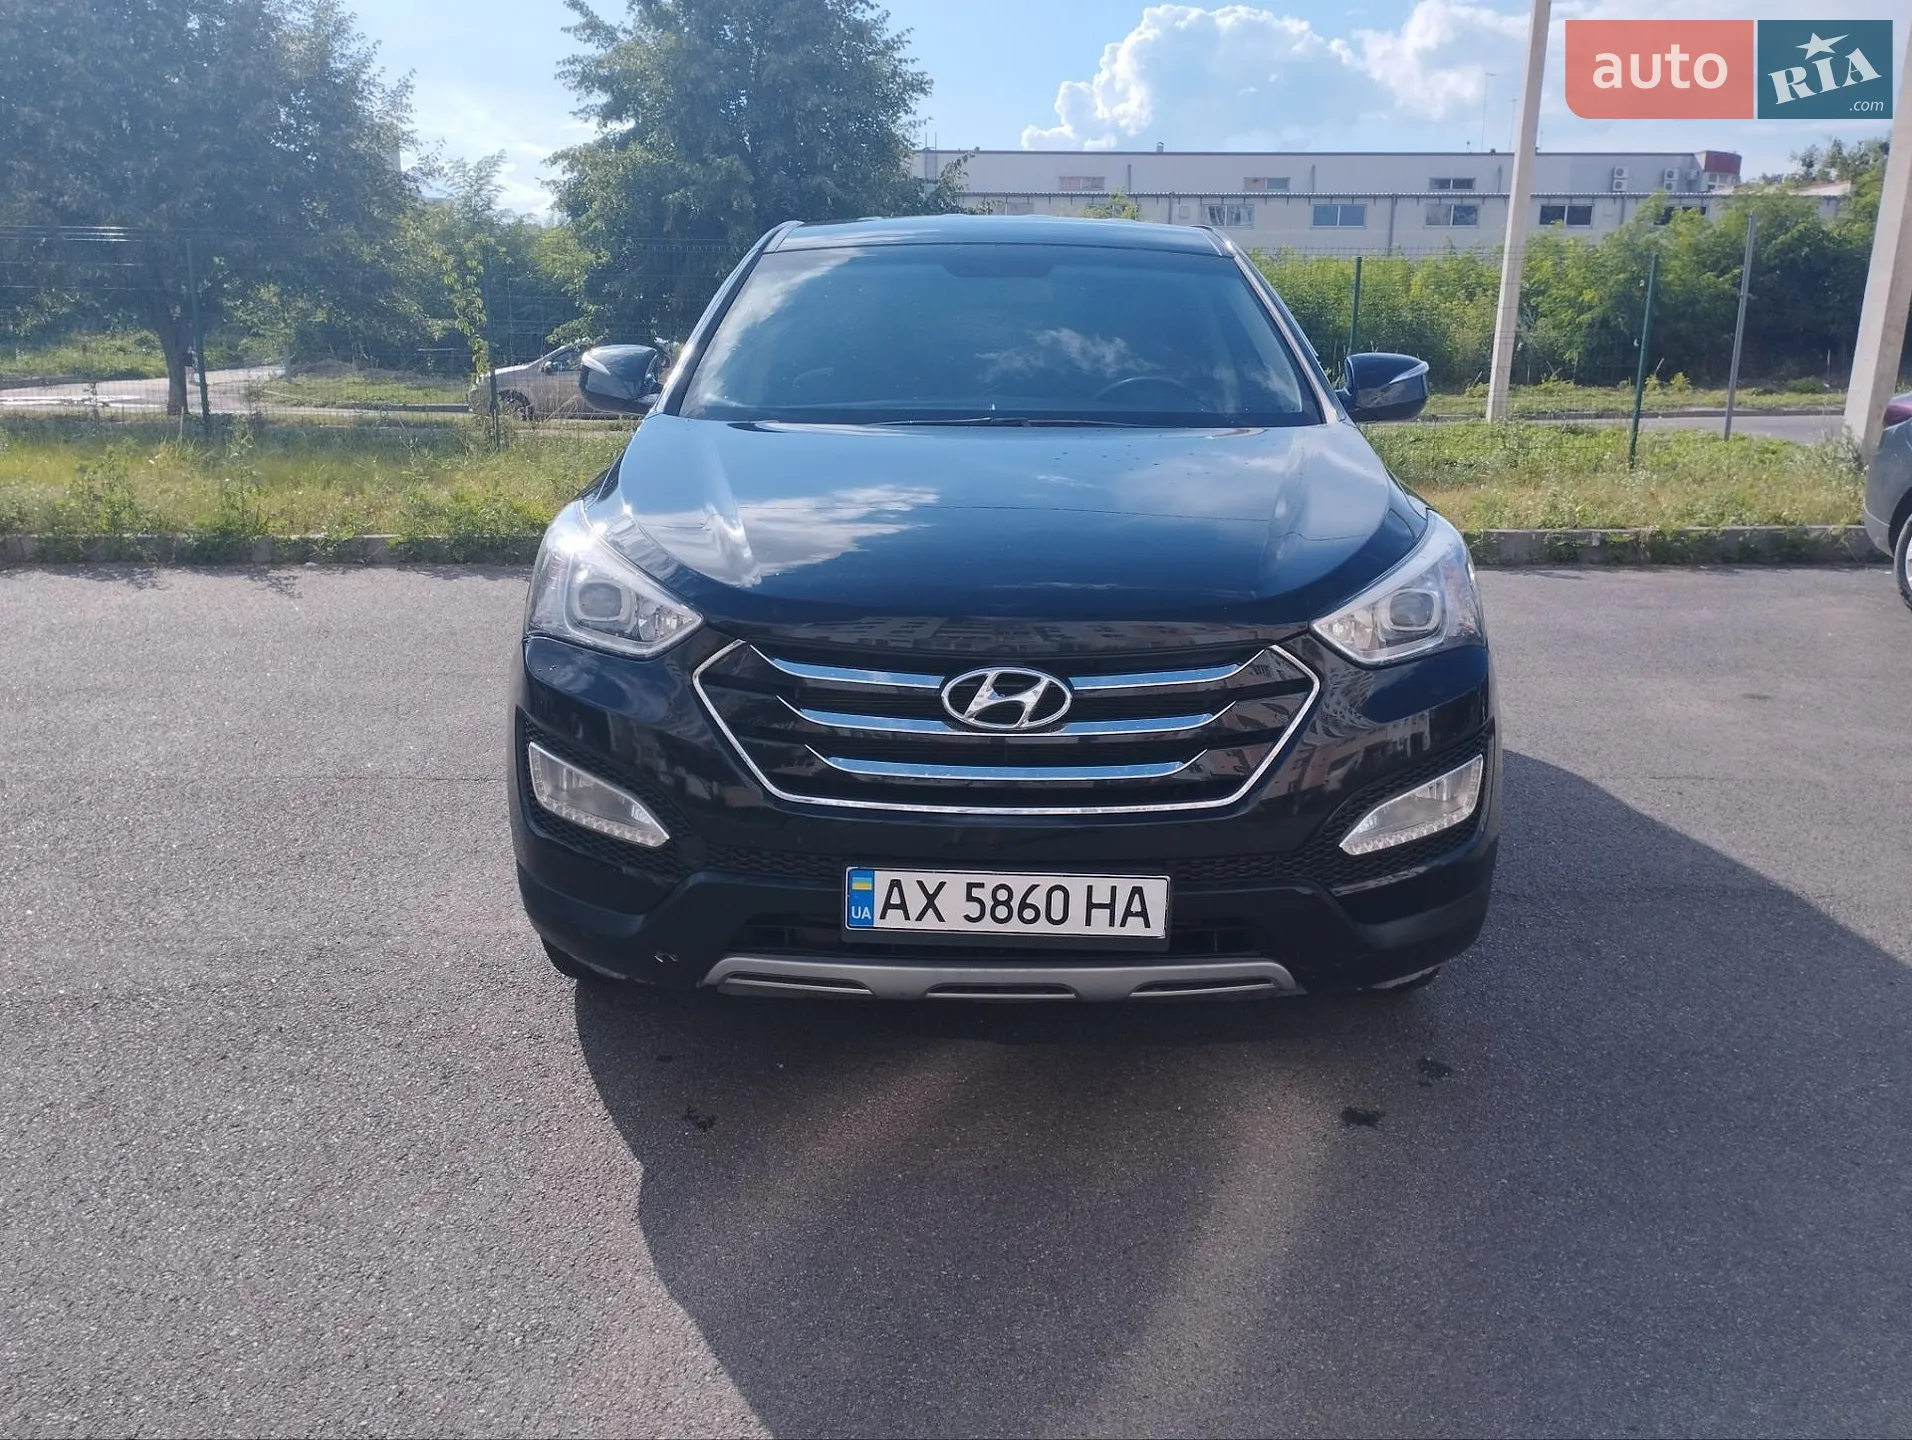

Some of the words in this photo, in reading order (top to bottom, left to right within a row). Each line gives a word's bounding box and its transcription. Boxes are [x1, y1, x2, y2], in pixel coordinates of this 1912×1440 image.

[851, 906, 872, 920] UA
[879, 878, 947, 923] AX
[963, 881, 1070, 926] 5860
[1084, 884, 1152, 929] HA
